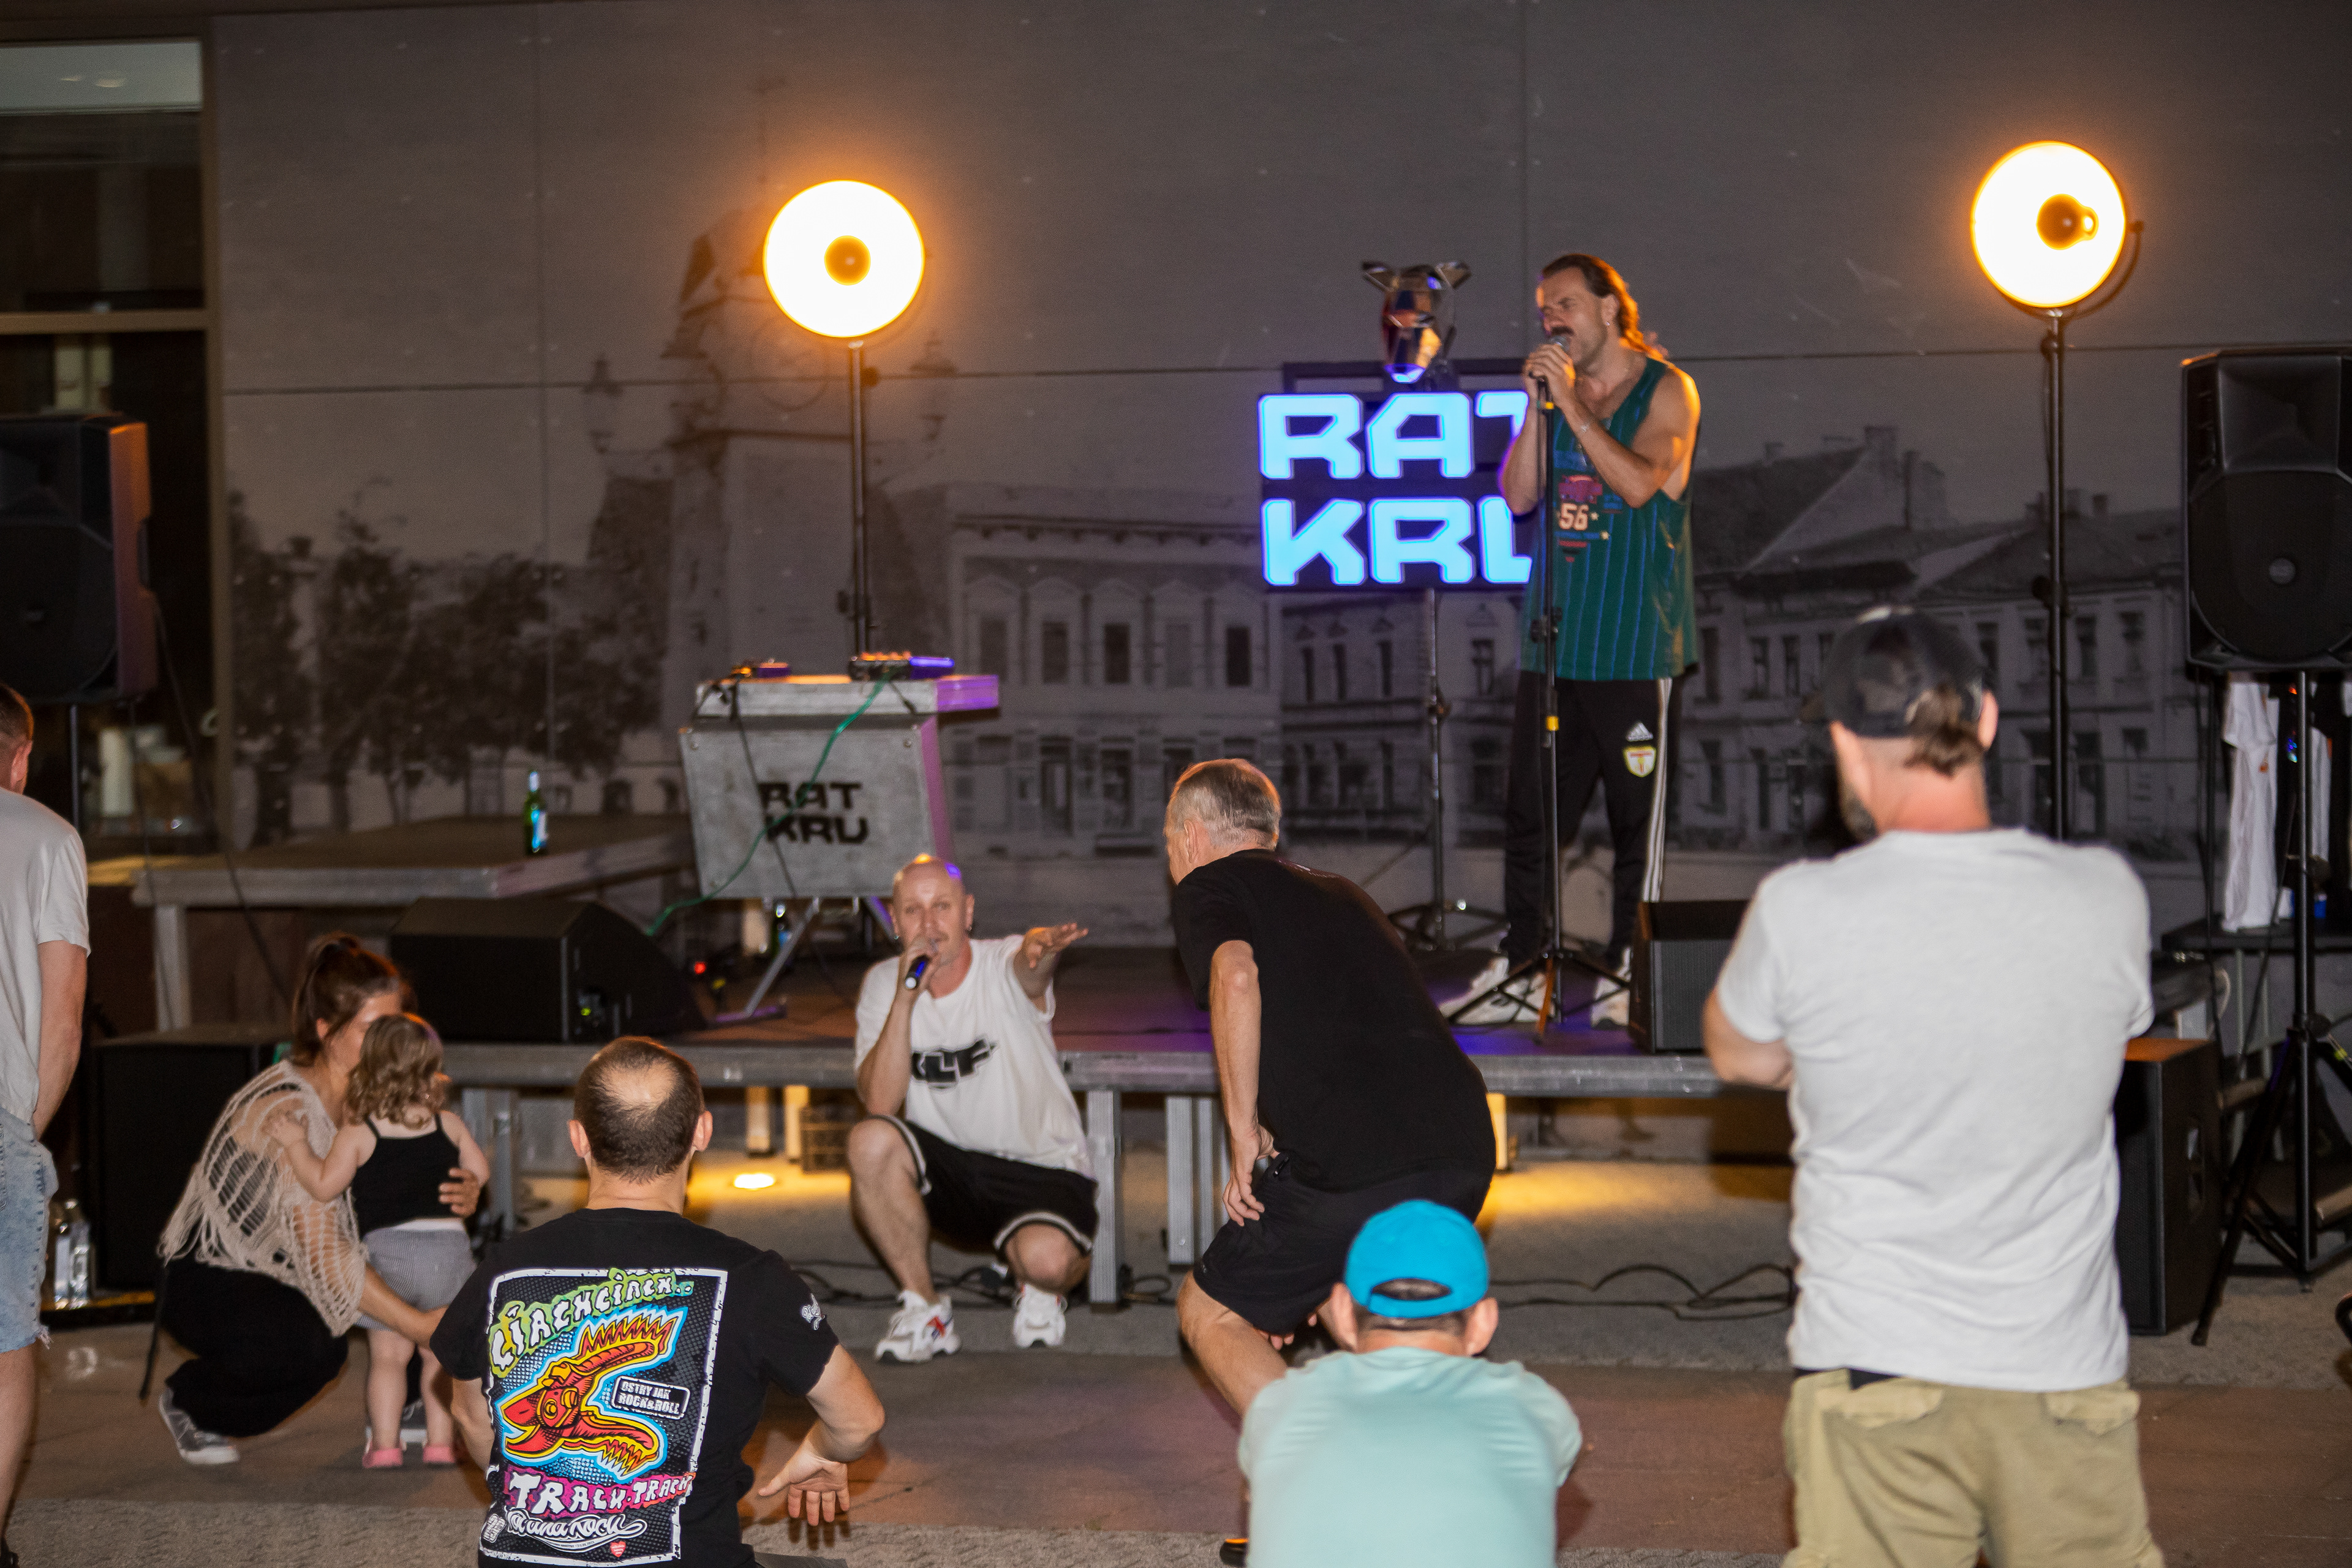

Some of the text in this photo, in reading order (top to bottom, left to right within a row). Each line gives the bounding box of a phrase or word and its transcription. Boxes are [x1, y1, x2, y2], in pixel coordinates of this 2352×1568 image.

[1559, 502, 1589, 531] 56
[758, 782, 861, 809] RAT
[764, 815, 869, 844] KRU
